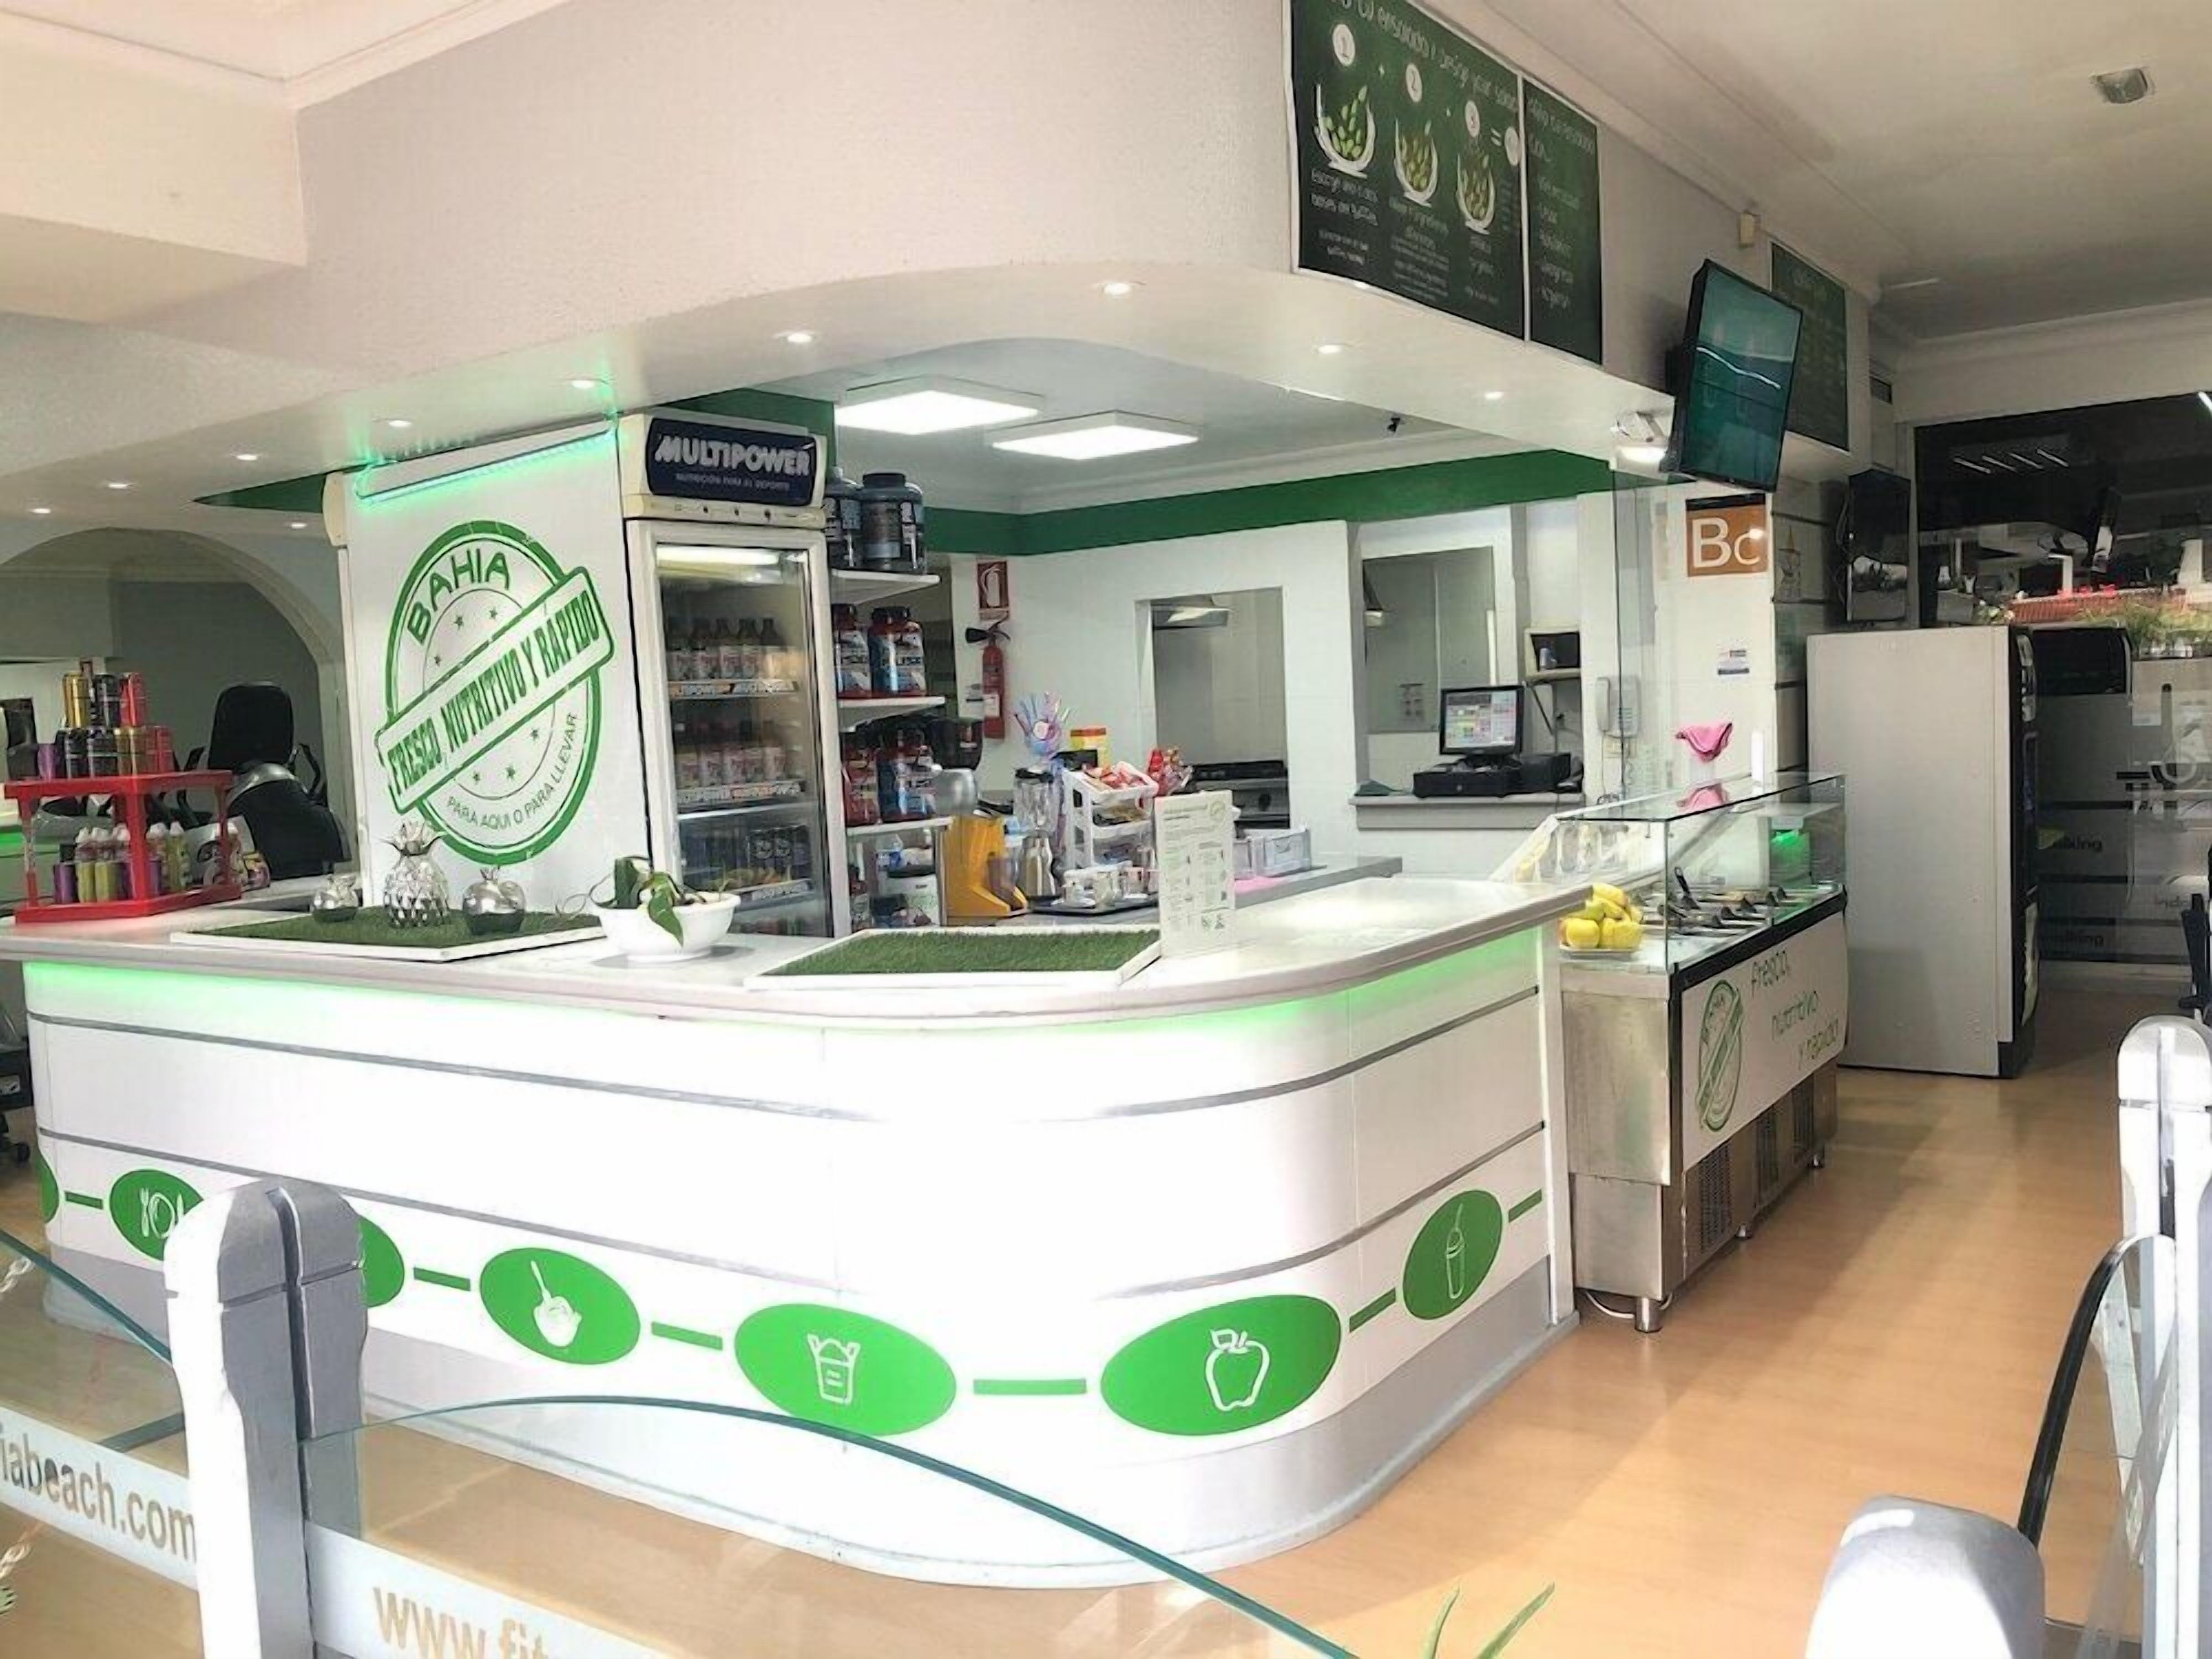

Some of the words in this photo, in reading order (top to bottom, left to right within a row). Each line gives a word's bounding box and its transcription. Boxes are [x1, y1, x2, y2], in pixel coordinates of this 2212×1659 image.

[655, 435, 810, 476] MULTIPOWER
[1692, 517, 1764, 568] Bc
[407, 548, 510, 644] BAHIA
[441, 648, 526, 753] NUTRITIVO
[520, 636, 539, 688] Y
[447, 796, 478, 826] PARA
[513, 809, 524, 824] O
[525, 782, 554, 818] PARA
[551, 712, 577, 783] LLEVAR
